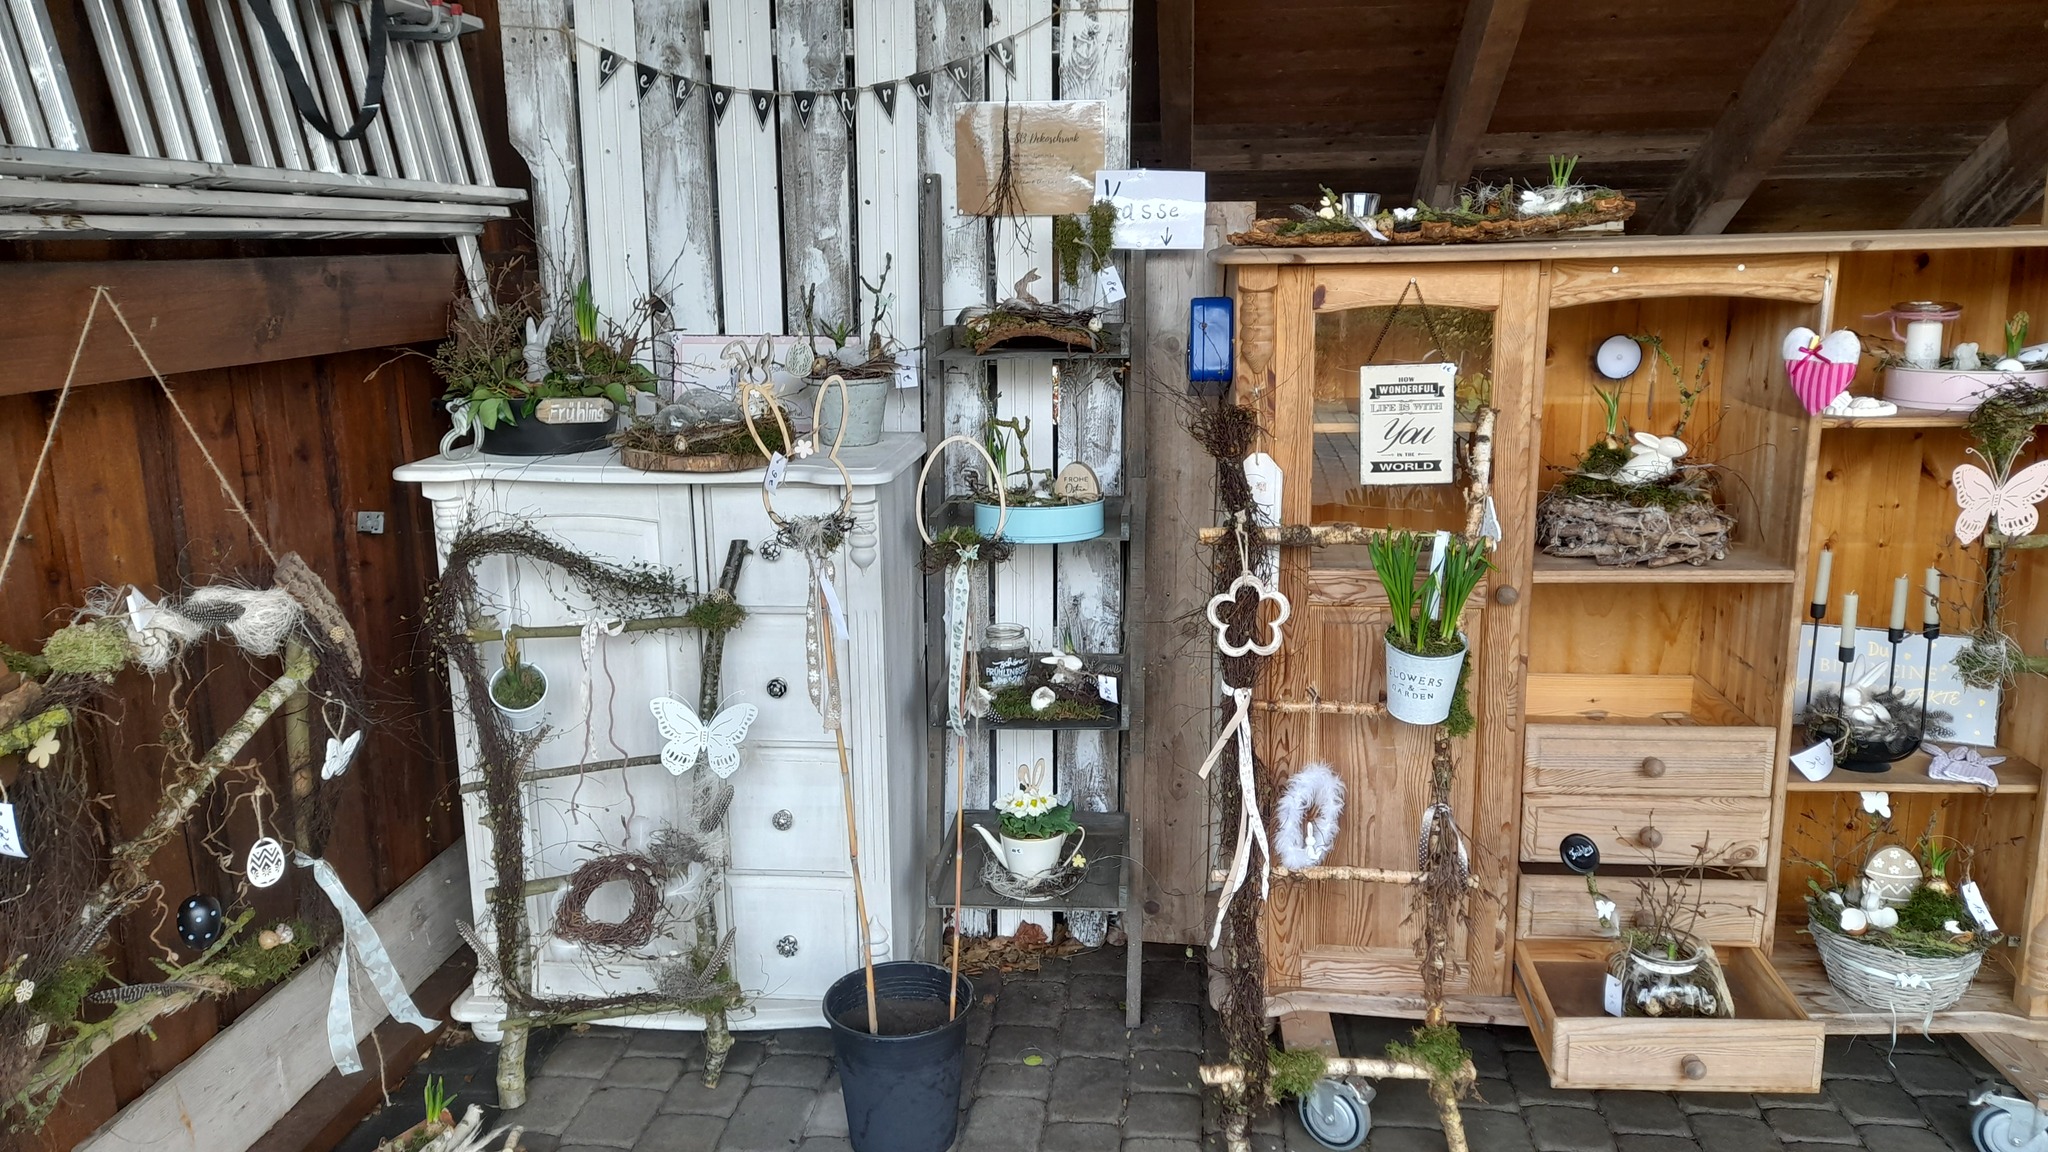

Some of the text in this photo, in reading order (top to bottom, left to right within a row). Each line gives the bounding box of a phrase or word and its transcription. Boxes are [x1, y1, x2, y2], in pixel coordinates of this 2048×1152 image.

[1030, 129, 1080, 144] Dekoschrank
[1379, 384, 1436, 394] WONDERFUL
[548, 401, 604, 422] Frühling
[1370, 402, 1443, 412] LIFE IS WITH
[1377, 417, 1436, 453] You
[1379, 462, 1434, 471] WORLD
[1868, 641, 1889, 658] Du
[1389, 665, 1443, 687] FLOWERS
[1391, 683, 1434, 700] GARDEN
[1407, 684, 1415, 692] &
